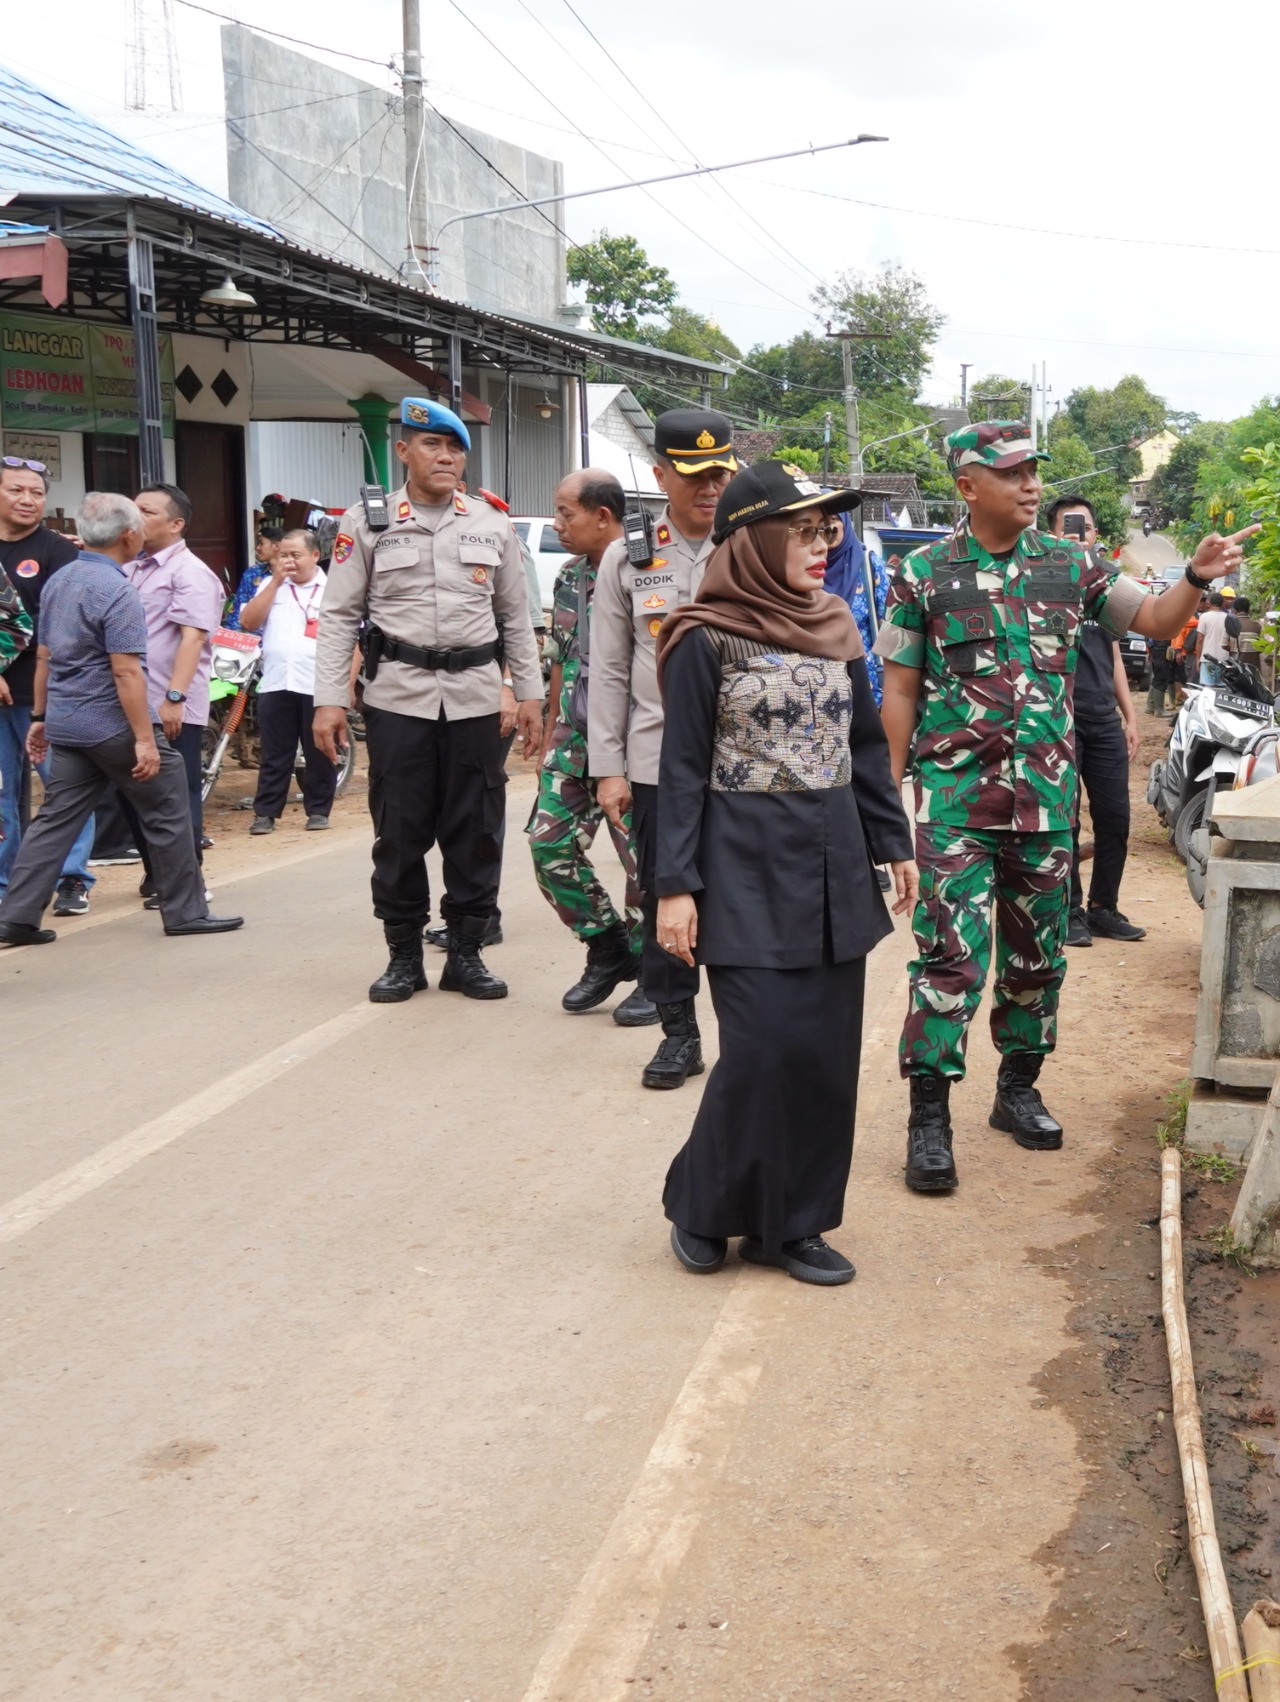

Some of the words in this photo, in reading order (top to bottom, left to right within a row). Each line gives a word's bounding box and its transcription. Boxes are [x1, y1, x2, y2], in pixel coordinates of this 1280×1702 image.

[2, 328, 84, 359] LANGGAR
[103, 334, 123, 352] TPQ
[6, 367, 84, 395] LEDHOAN
[376, 539, 401, 548] DIDIK
[460, 535, 495, 545] POLRI
[635, 575, 674, 587] DODIK
